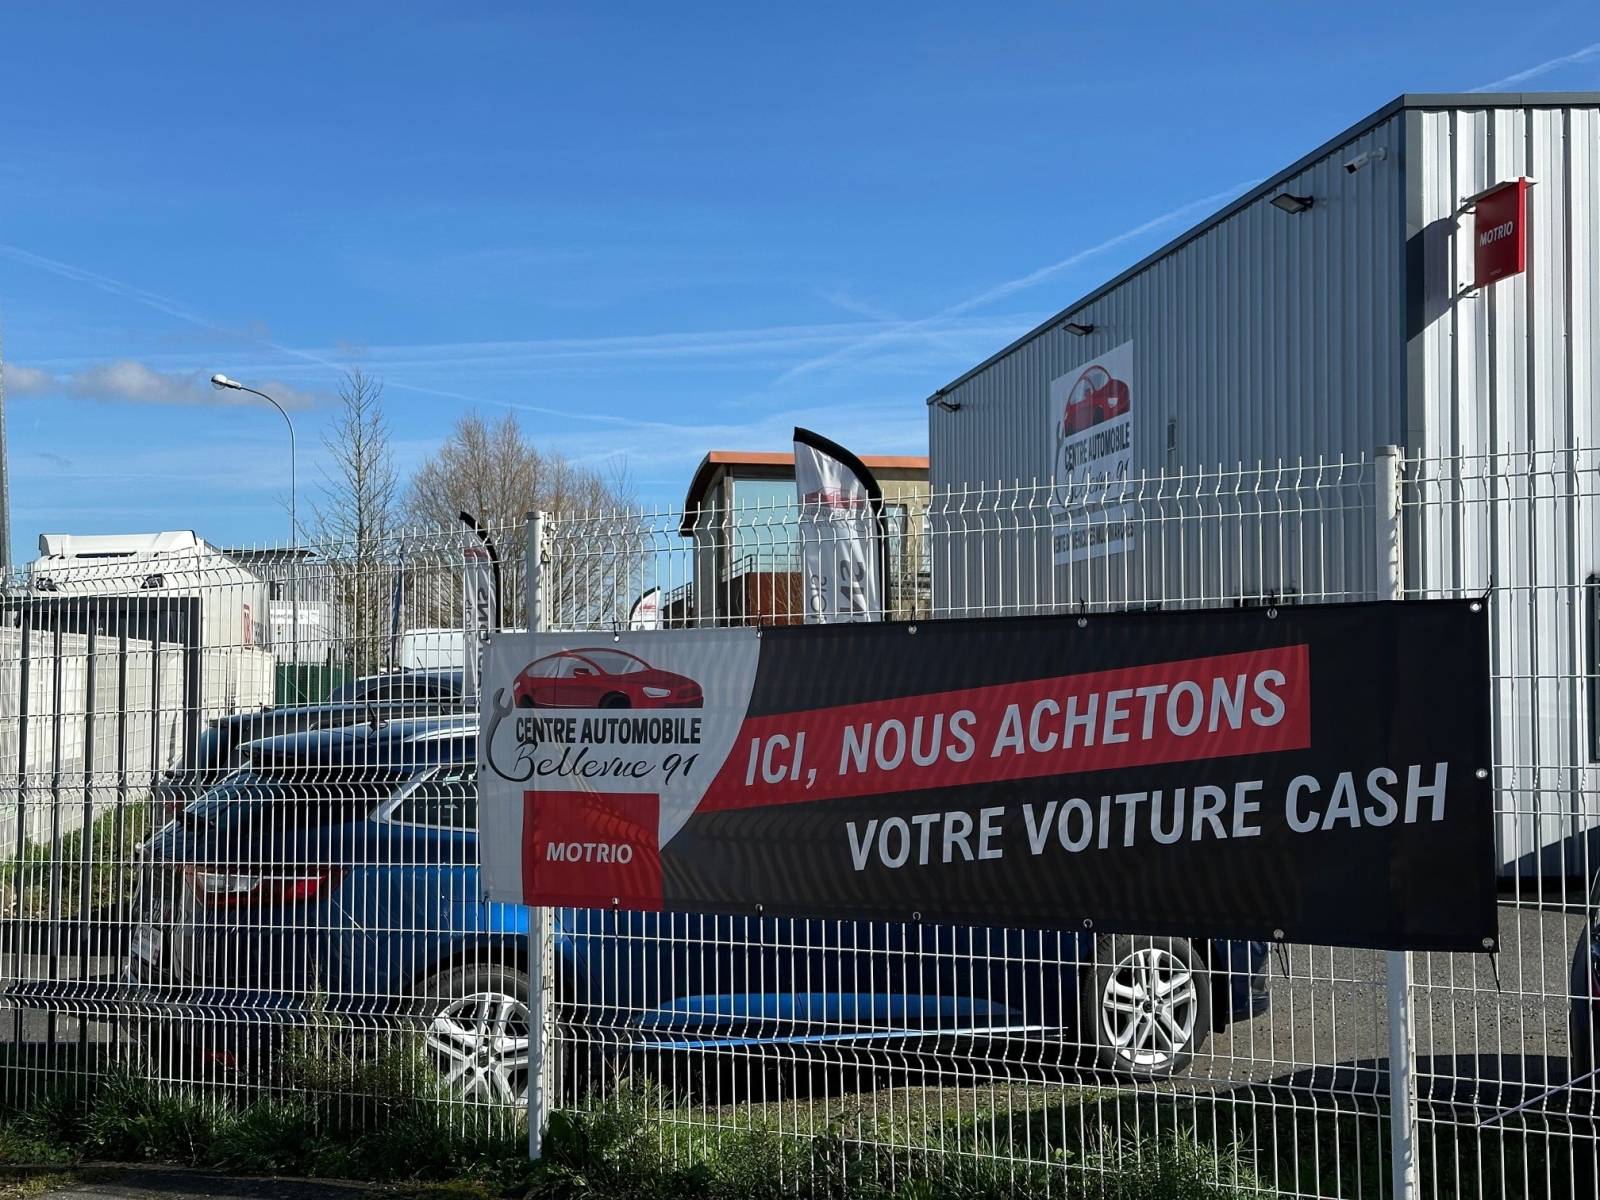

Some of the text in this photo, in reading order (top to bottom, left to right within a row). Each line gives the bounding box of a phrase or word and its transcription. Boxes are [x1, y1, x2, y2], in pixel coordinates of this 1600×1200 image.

[1480, 221, 1513, 247] MOTRIO
[1065, 422, 1130, 469] CENTRE AUTOMOBILE
[516, 717, 702, 744] CENTRE AUTOMOBILE
[745, 669, 1286, 789] ICI, NOUS ACHETONS
[507, 739, 700, 785] Bellevue 91
[846, 762, 1449, 871] VOTRE VOITURE CASH
[546, 842, 633, 863] MOTRIO
